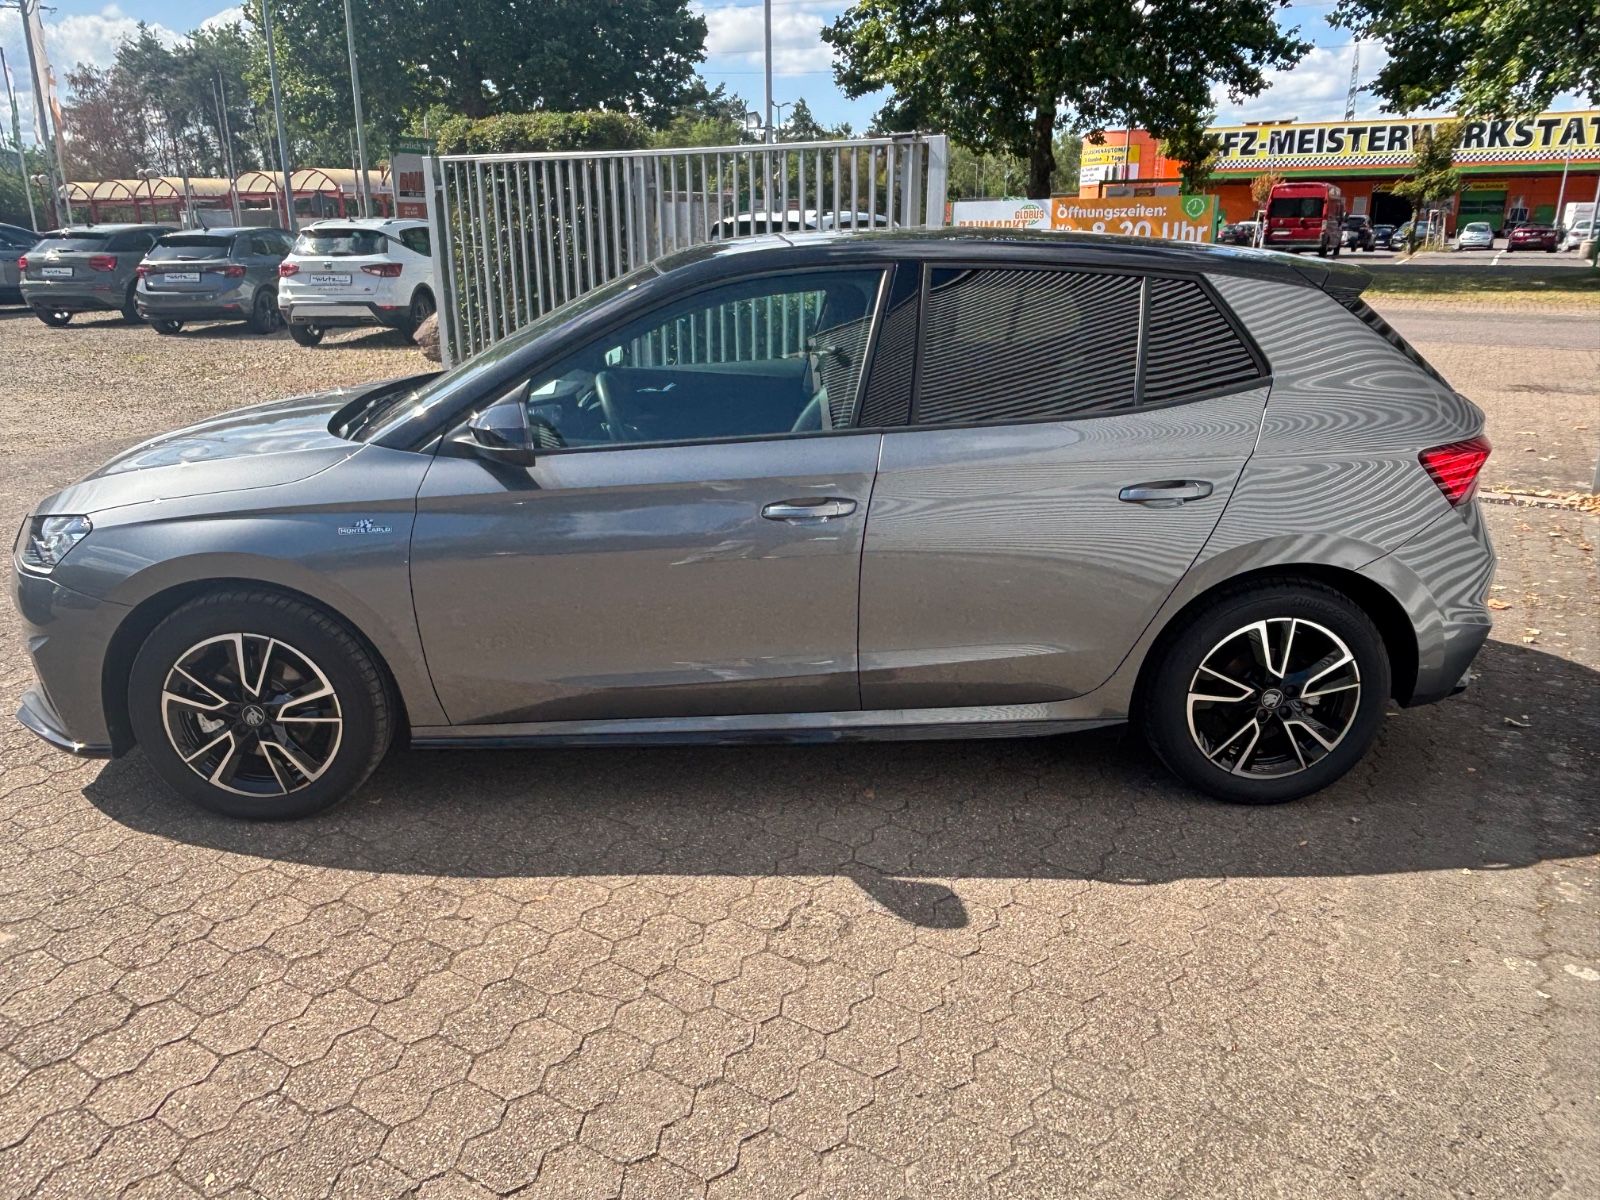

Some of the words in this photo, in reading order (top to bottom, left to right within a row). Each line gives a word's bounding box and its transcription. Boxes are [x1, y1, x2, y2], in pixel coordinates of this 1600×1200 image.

[1203, 117, 1600, 157] FZ-MEISTERRKSTA
[1015, 210, 1044, 219] GLOBUS
[1056, 204, 1167, 221] Öffnungszeiten:
[1162, 221, 1208, 242] Uhr
